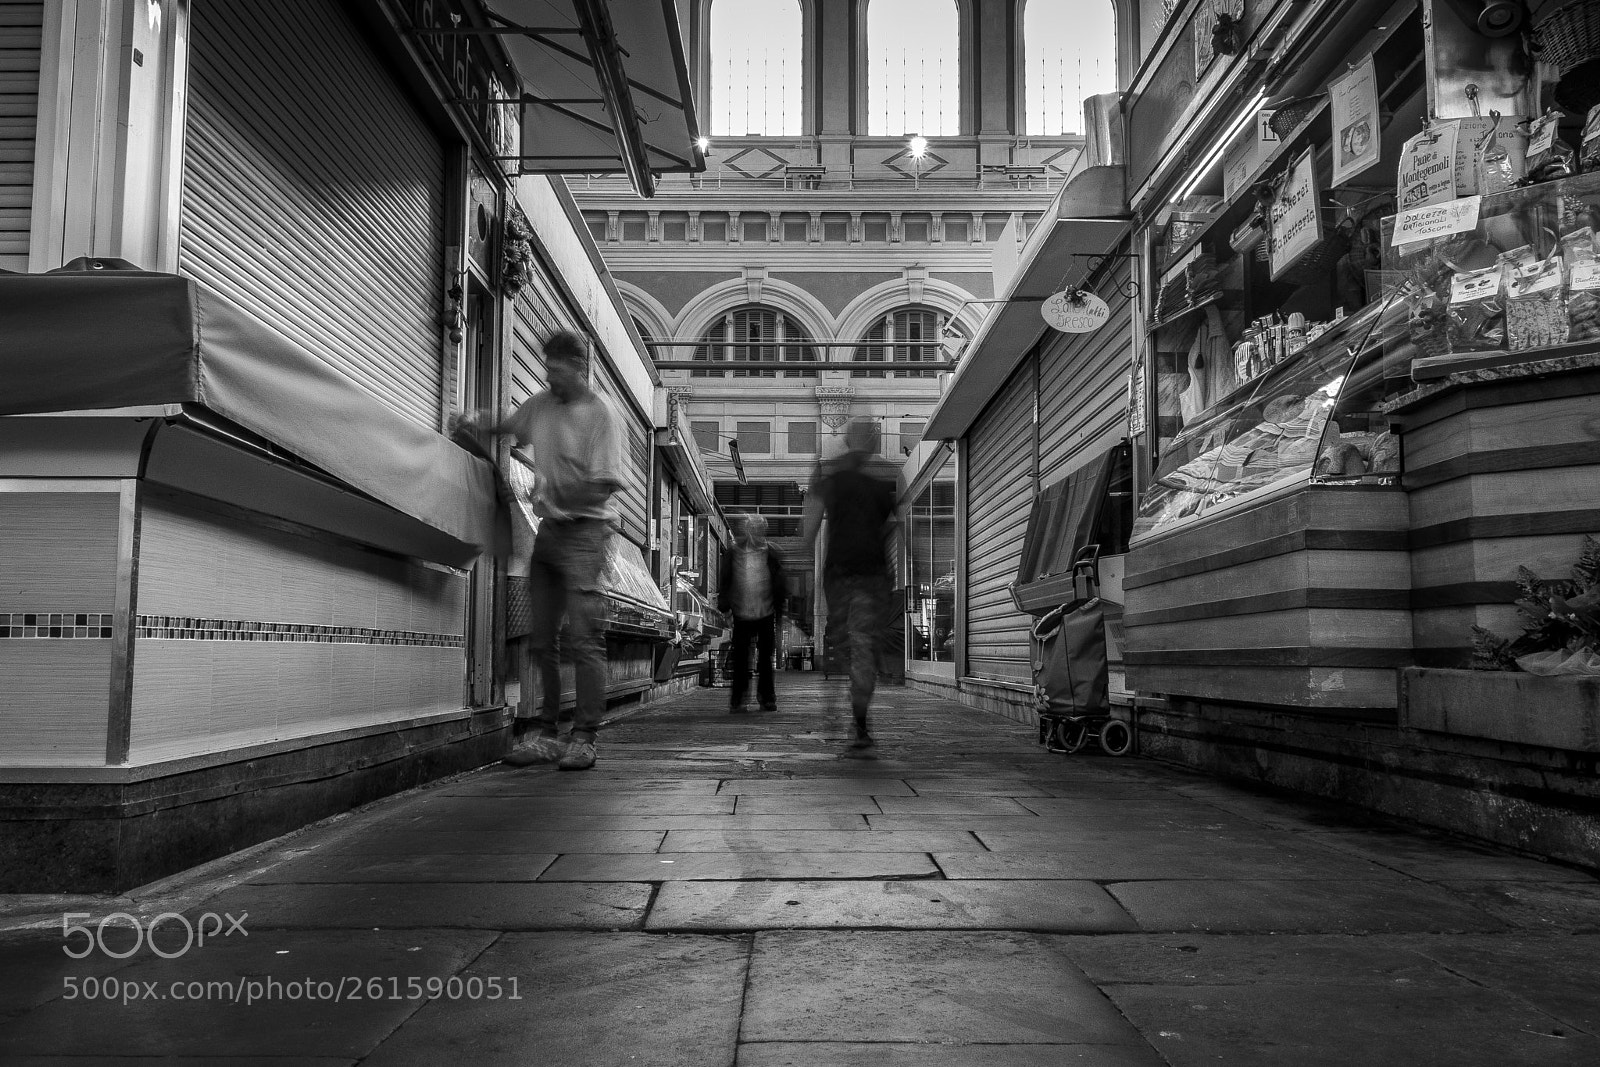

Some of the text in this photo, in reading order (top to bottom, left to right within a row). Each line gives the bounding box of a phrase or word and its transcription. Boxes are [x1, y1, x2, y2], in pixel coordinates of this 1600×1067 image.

[1402, 155, 1450, 188] Montegemoli
[1413, 153, 1432, 171] Pane
[669, 392, 678, 444] POLLERIA
